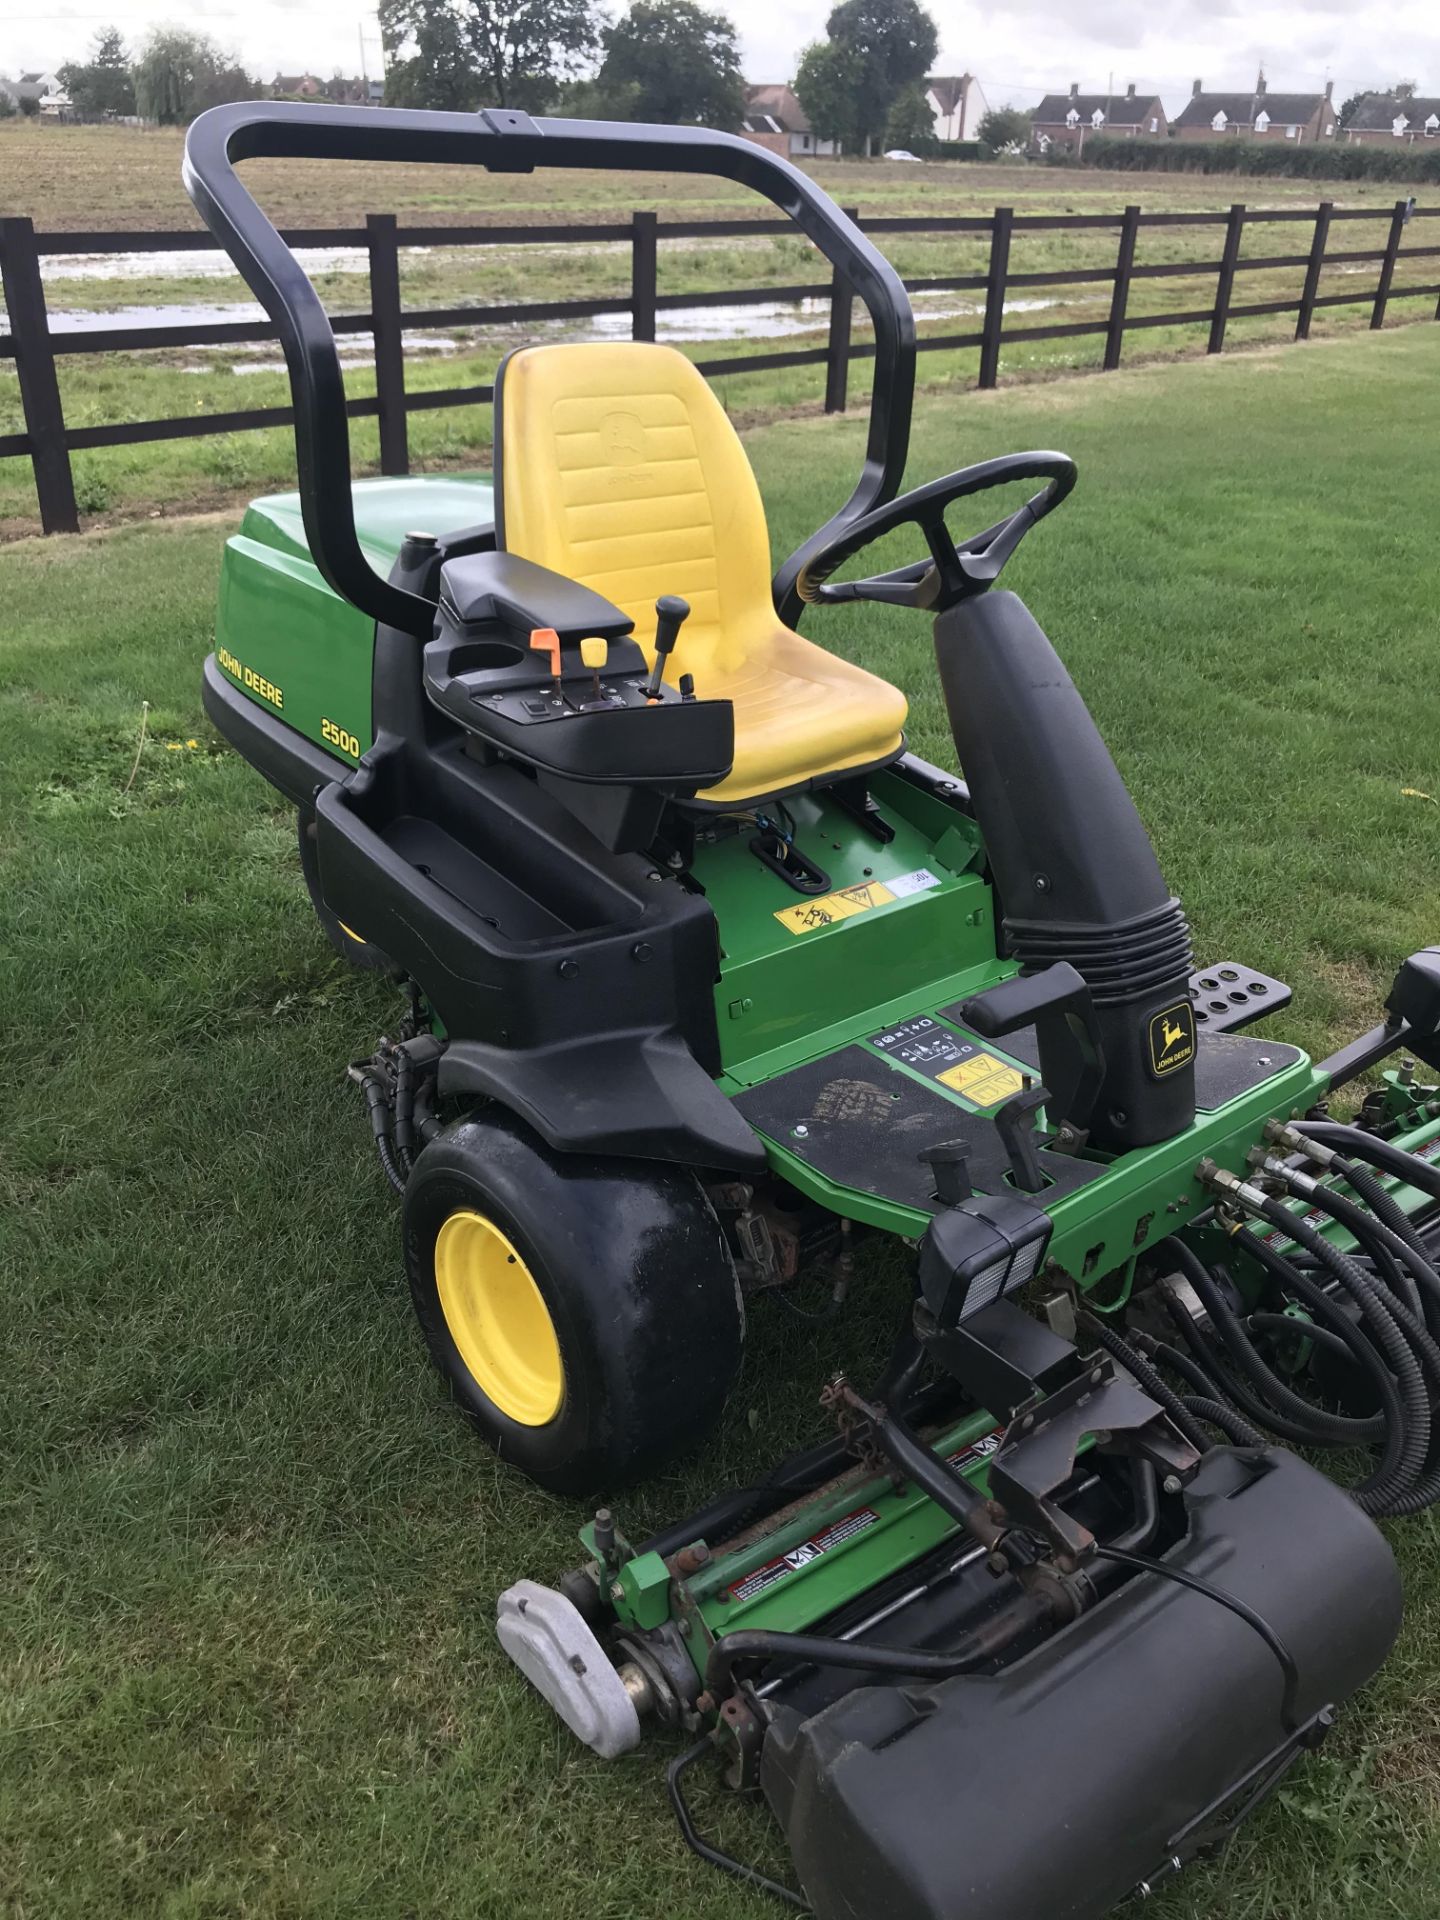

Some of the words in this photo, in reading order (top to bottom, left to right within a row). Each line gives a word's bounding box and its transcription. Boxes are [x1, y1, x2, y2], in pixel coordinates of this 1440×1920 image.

[218, 647, 242, 680] JOHN
[244, 667, 284, 709] DEERE
[321, 718, 360, 758] 2500
[1157, 1056, 1174, 1069] JOHN
[1174, 1047, 1191, 1060] DEERE
